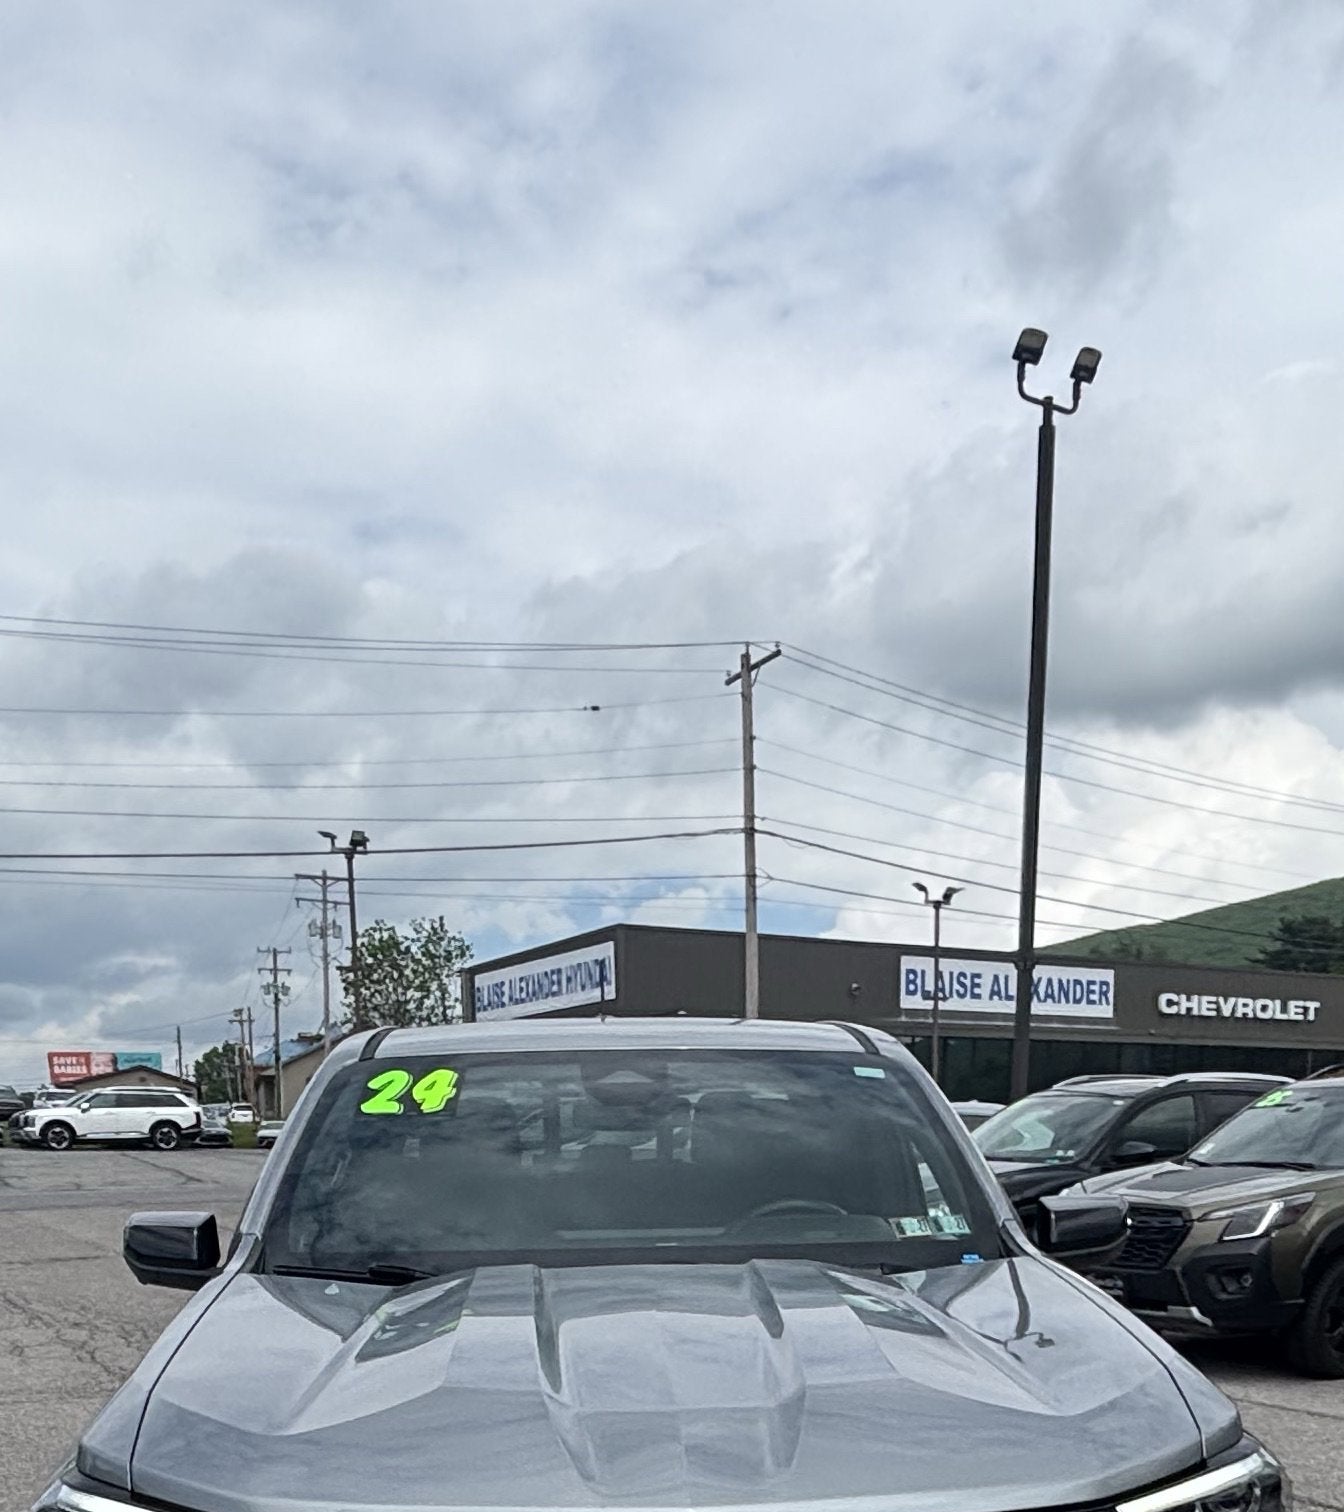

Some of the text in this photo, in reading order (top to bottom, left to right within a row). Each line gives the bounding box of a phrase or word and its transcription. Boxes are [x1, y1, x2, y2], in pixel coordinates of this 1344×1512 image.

[476, 955, 612, 1013] BLAISE ALEXANDER HYUNDAI
[905, 968, 1111, 1006] BLAISE ALXANDER
[1158, 992, 1321, 1021] CHEVROLET
[360, 1069, 459, 1115] 24
